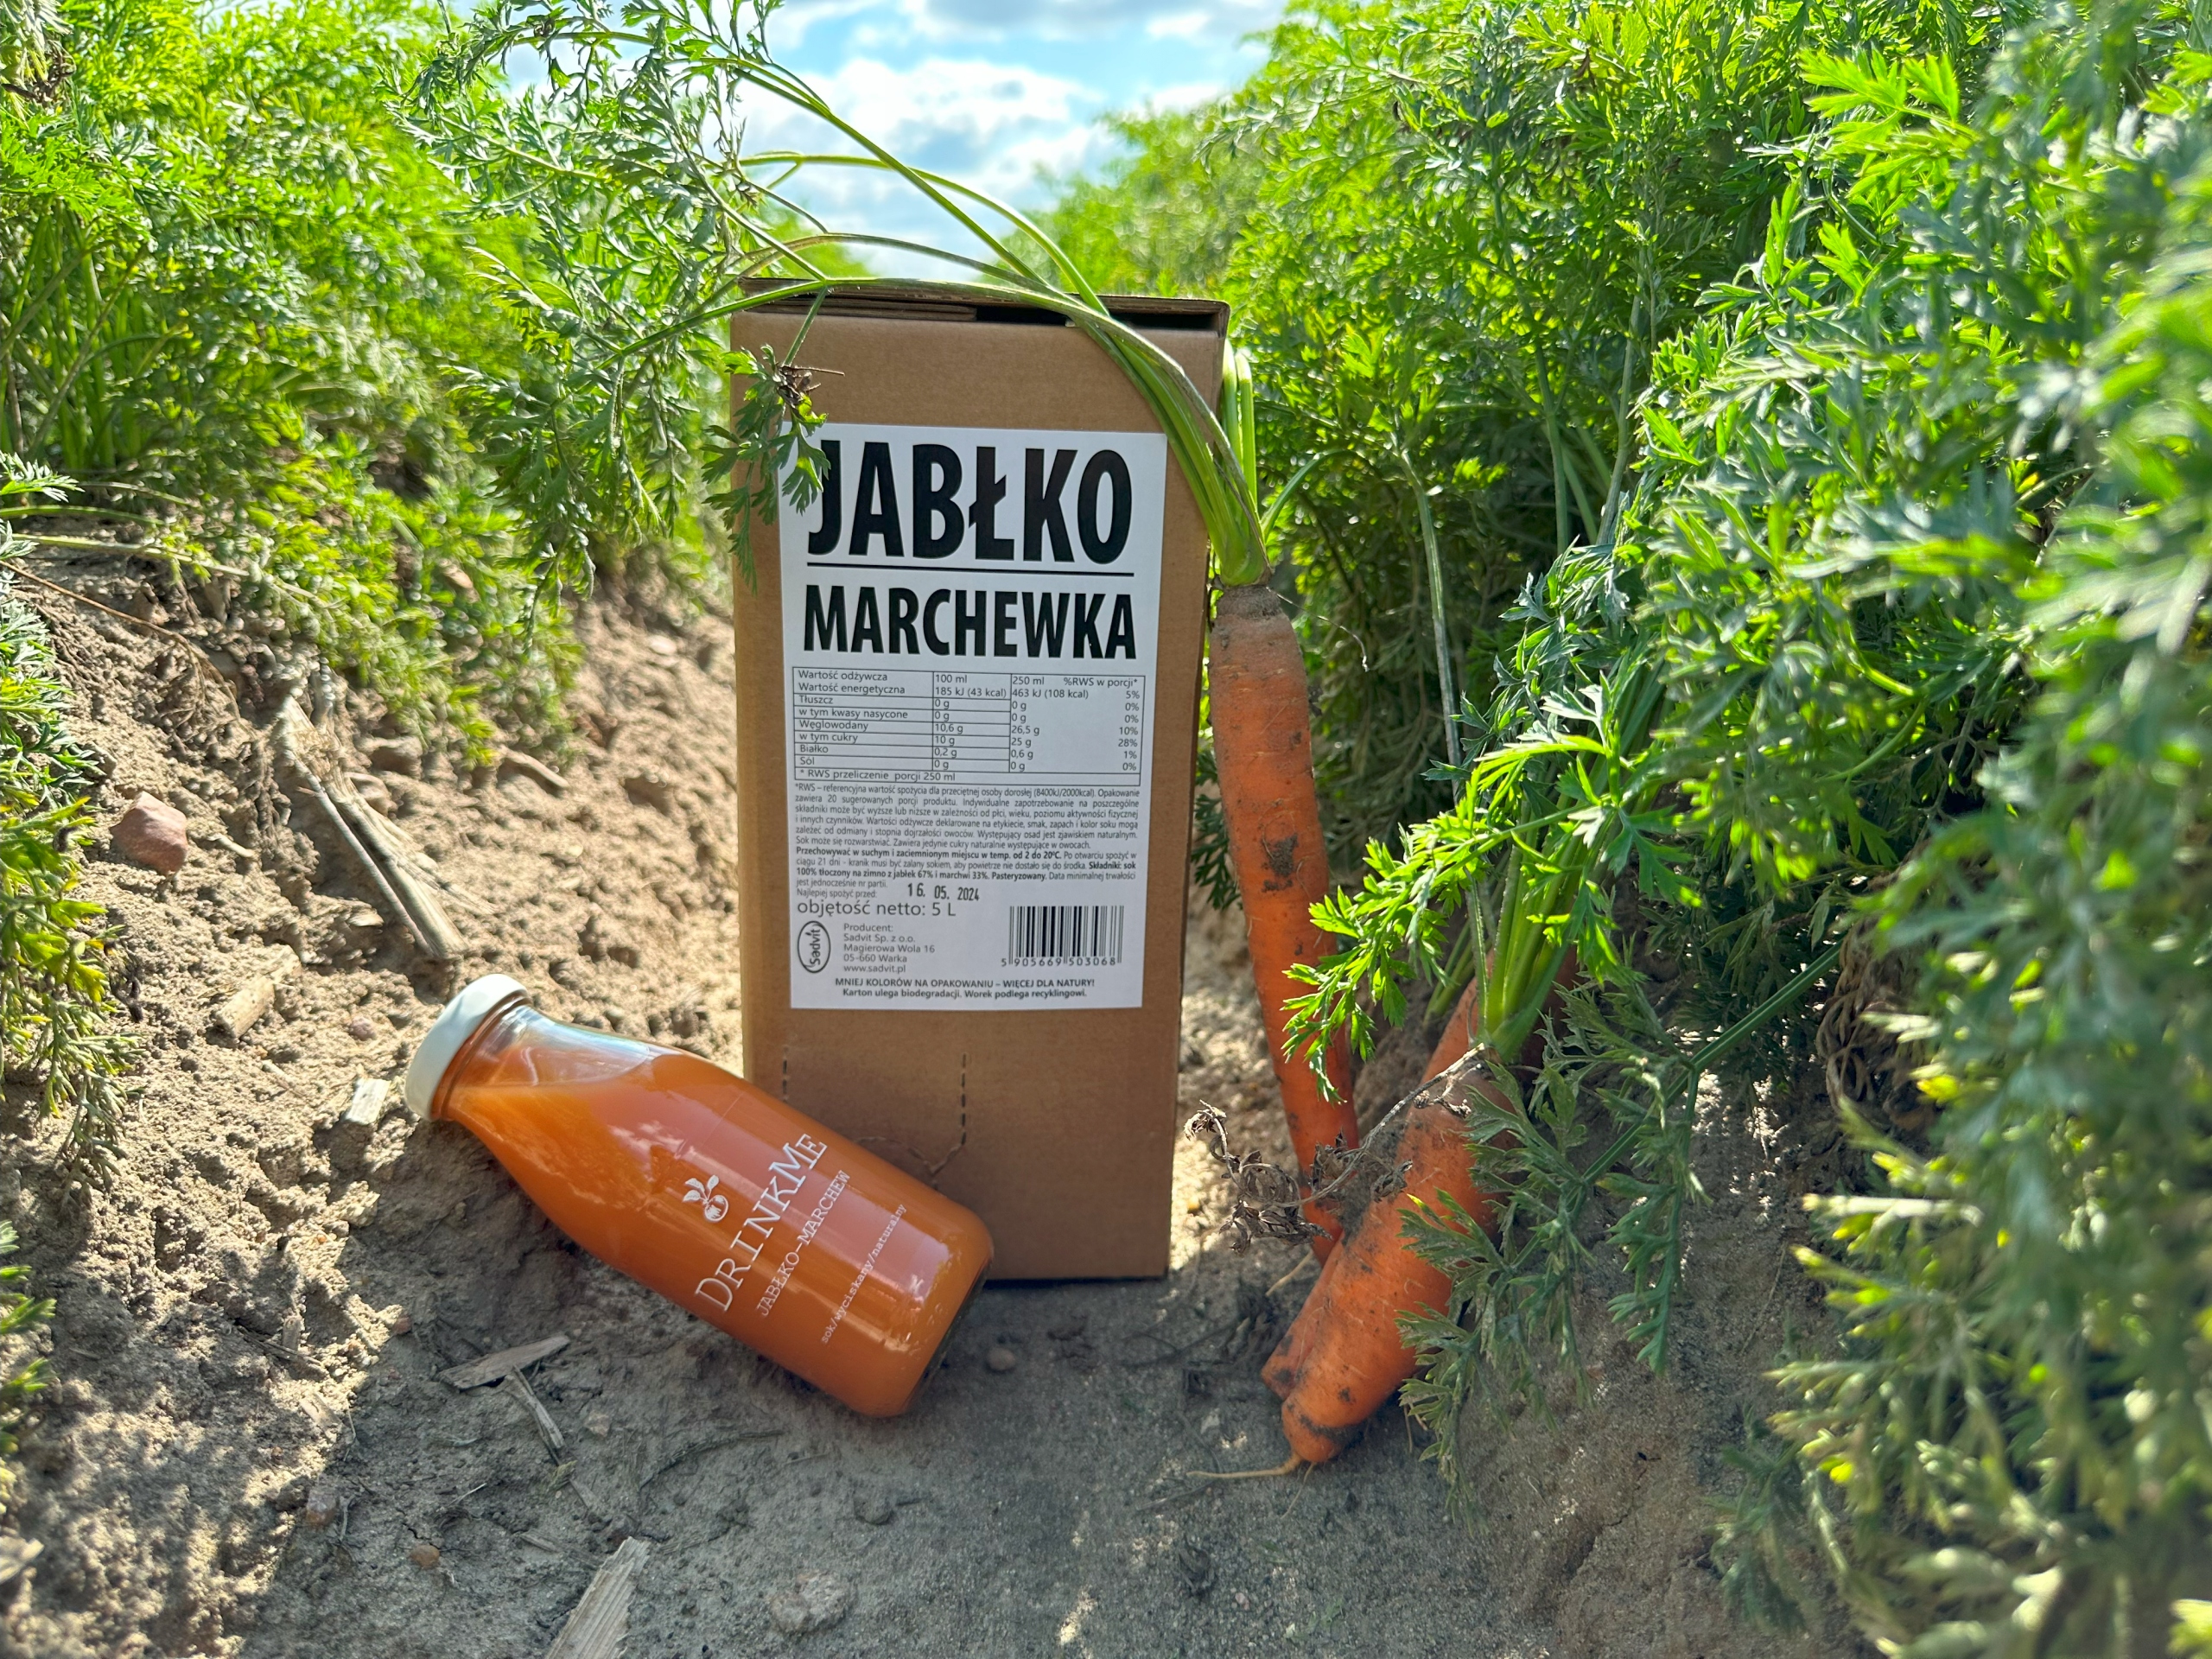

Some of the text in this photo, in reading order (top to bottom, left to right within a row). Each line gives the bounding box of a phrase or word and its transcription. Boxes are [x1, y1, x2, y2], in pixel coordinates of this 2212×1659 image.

[807, 439, 1133, 565] JABŁKO
[804, 584, 1136, 659] MARCHEWKA
[798, 670, 888, 682] Wartość odżywcza
[935, 674, 968, 683] 100 ml
[1012, 676, 1045, 685] 250 ml
[1063, 677, 1094, 686] %RWS
[798, 683, 906, 696] Wartość energetyczna
[935, 687, 1007, 698] 185 kJ (43 kcal)
[1033, 690, 1042, 698] kJ
[1044, 690, 1065, 699] (108
[1067, 690, 1089, 699] kcal)
[1125, 690, 1140, 699] 5%
[799, 695, 834, 704] Tłuszcz
[934, 698, 950, 709] 0 g
[1012, 701, 1027, 711] 0 g
[1125, 702, 1140, 711] 0%
[810, 709, 829, 718] tym
[831, 709, 861, 719] kwasy
[863, 710, 908, 721] nasycone
[944, 713, 950, 721] g
[1012, 713, 1027, 723] 0 g
[1124, 715, 1139, 723] 0%
[799, 720, 868, 732] Węglowodany
[935, 723, 963, 734] 10,6 g
[1011, 725, 1039, 736] 26,5 g
[1119, 727, 1139, 735] 10%
[810, 734, 829, 743] tym
[831, 734, 858, 744] cukry
[935, 735, 955, 747] 10 g
[1011, 737, 1032, 748] 25 g
[799, 744, 829, 753] Białko
[934, 747, 957, 759] 0,2 g
[1010, 749, 1033, 760] 0,6 g
[800, 756, 815, 765] Sól
[934, 760, 949, 770] 0 g
[1010, 761, 1025, 772] 0 g
[1122, 762, 1137, 771] 0%
[808, 769, 830, 778] RWS
[833, 770, 889, 780] przeliczenie
[894, 772, 921, 783] porcji
[923, 772, 941, 781] 250
[944, 772, 956, 781] ml
[823, 784, 867, 794] referencyjna
[868, 785, 895, 794] wartość
[897, 785, 927, 796] spożycia
[929, 786, 939, 795] dla
[941, 786, 980, 798] przeciętnej
[981, 788, 1002, 798] osoby
[1004, 788, 1032, 798] dorosłej
[1097, 789, 1140, 798] Opakowanie
[795, 794, 823, 803] zawiera
[828, 794, 836, 803] 20
[842, 796, 893, 805] sugerowanych
[899, 798, 918, 807] porcji
[923, 798, 957, 807] produktu.
[963, 798, 1009, 808] Indywidualne
[1014, 799, 1074, 808] zapotrzebowanie
[1092, 800, 1139, 810] poszczególne
[818, 868, 850, 878] tłoczony
[893, 868, 916, 880] jabłek
[992, 872, 1047, 881] Pasteryzowany.
[1066, 872, 1104, 881] minimalnej
[1105, 872, 1135, 880] trwałości
[796, 878, 809, 887] jest
[810, 879, 856, 888] jednocześnie
[868, 880, 887, 889] partii.
[797, 888, 877, 899] Najlepiej spożyć przed:
[934, 885, 950, 899] 05.
[957, 887, 980, 901] 2024
[798, 899, 956, 918] objętość netto: 5 L
[843, 923, 893, 932] Producent:
[843, 933, 872, 942] Sadvit
[874, 934, 889, 944] Sp.
[809, 928, 821, 966] Sadvit
[843, 944, 895, 954] Magierowa
[897, 944, 921, 953] Wola
[843, 954, 907, 963] 05-660 Warka
[843, 964, 906, 974] www.sadvit.pl
[866, 976, 912, 987] KOLORÓW
[914, 978, 928, 987] NA
[931, 979, 993, 988] OPAKOWANIU
[1003, 979, 1034, 989] WIĘCEJ
[1037, 979, 1054, 988] DLA
[842, 988, 1087, 1000] Karton ulega biodegradacji. Worek podlega recyklingowi.
